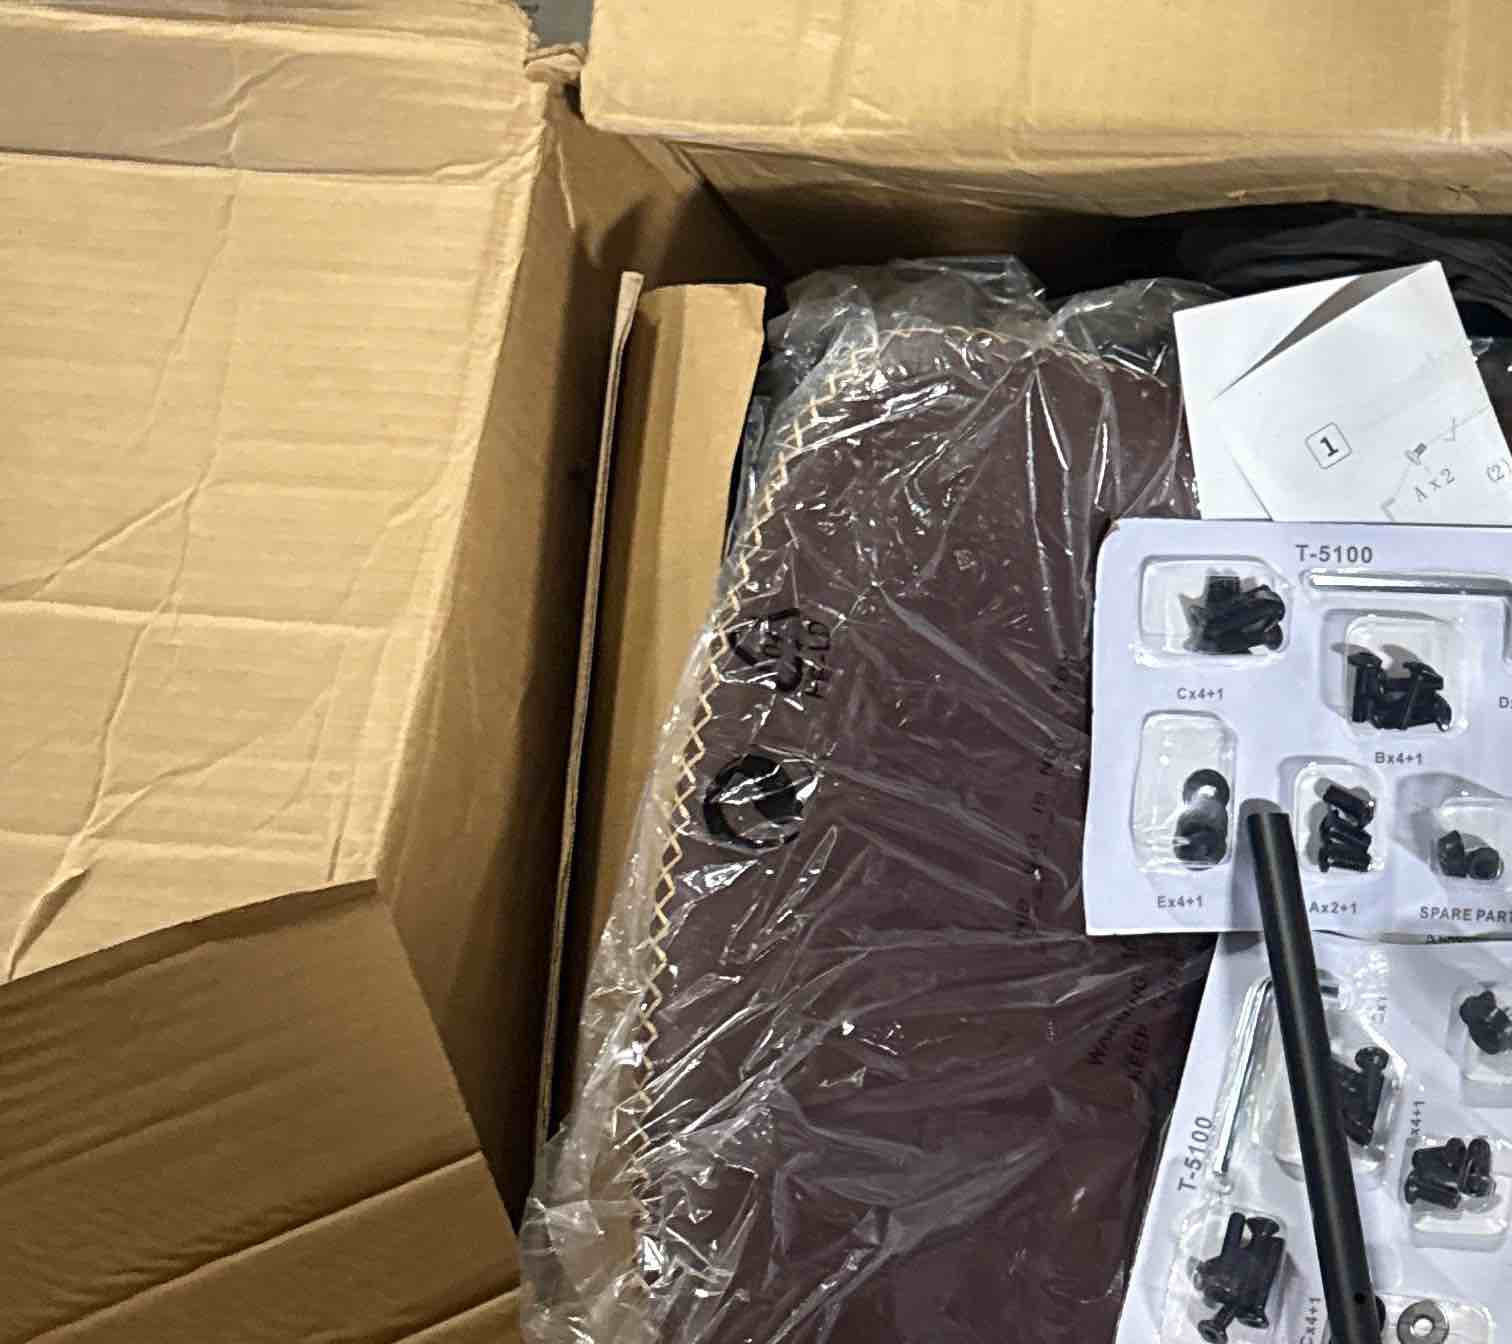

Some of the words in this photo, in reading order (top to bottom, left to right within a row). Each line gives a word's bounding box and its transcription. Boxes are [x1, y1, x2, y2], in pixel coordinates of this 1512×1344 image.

[1320, 435, 1337, 459] 1
[1295, 543, 1374, 565] T-5100
[1176, 685, 1225, 702] Cx4+1
[1374, 750, 1424, 766] Bx4+1
[1156, 893, 1204, 910] Ex4+1
[1308, 900, 1358, 918] Ax2+1
[1418, 905, 1471, 923] SPARE
[1405, 1099, 1426, 1148] x4+1
[1176, 1115, 1213, 1193] T-5100
